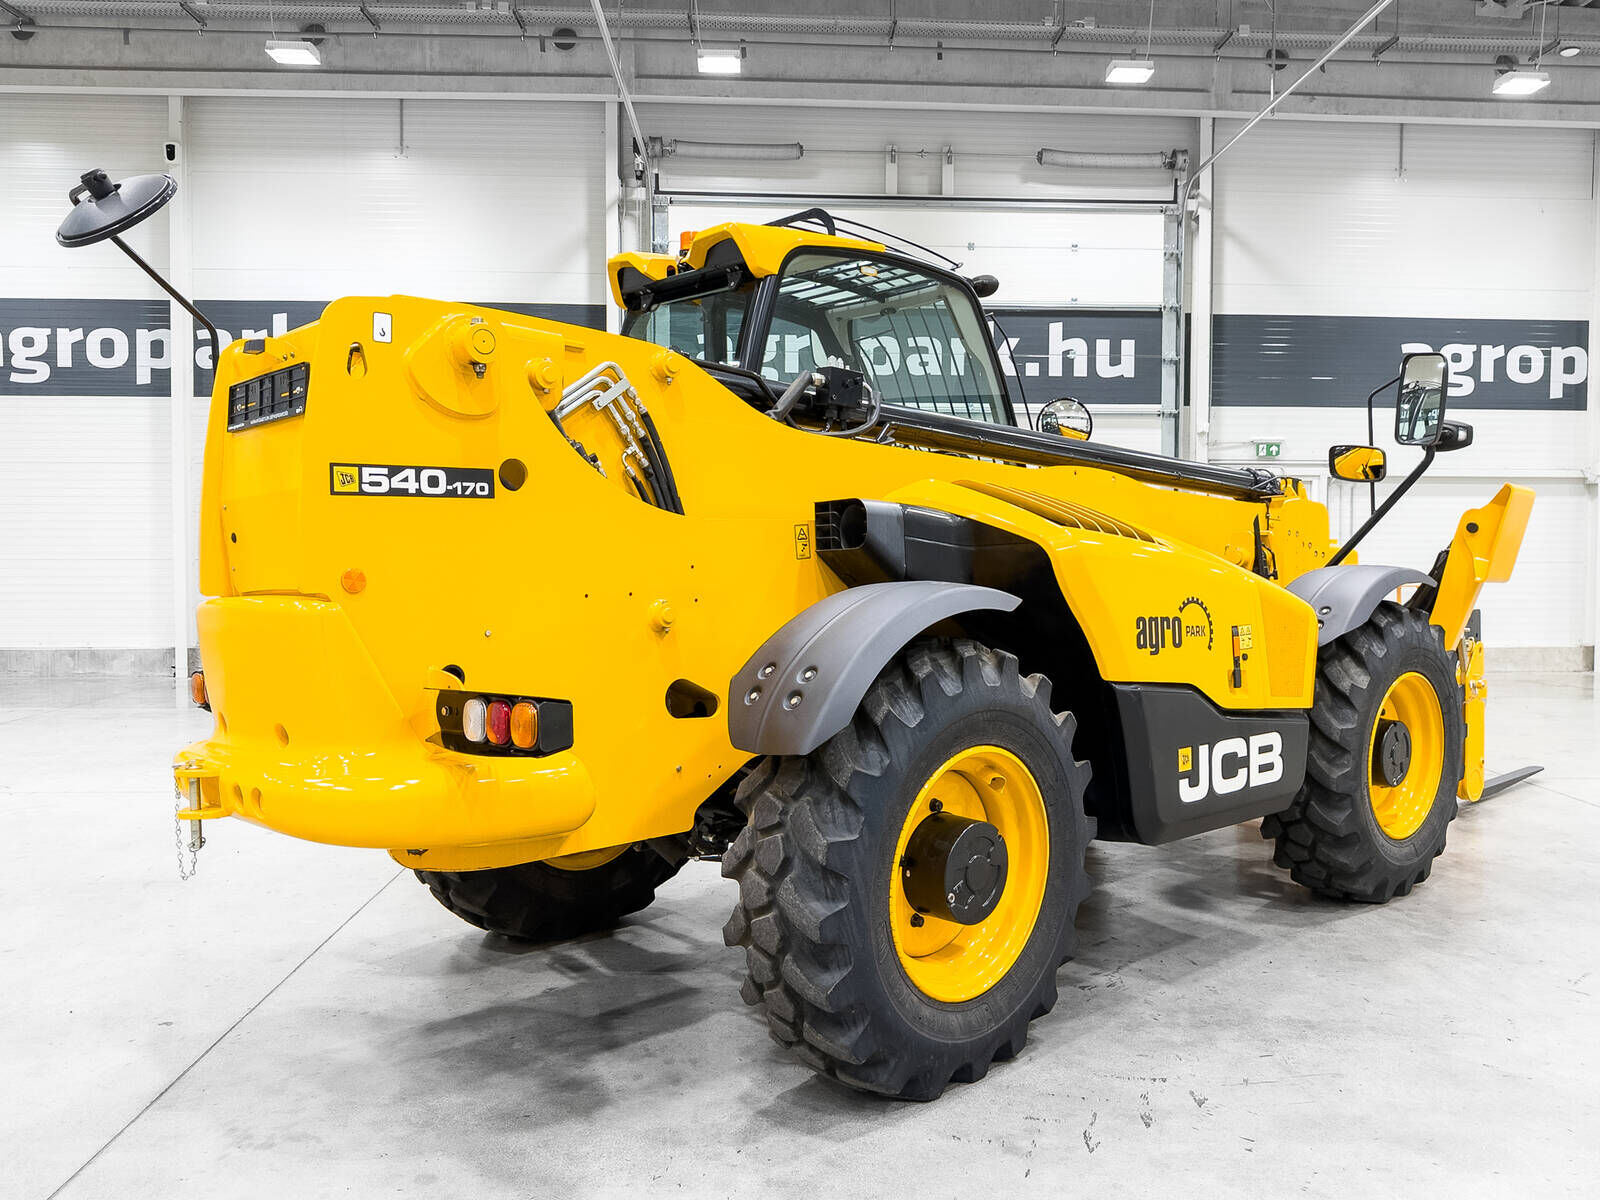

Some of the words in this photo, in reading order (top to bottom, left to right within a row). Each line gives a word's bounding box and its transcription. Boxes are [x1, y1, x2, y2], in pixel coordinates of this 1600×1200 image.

[1400, 343, 1588, 399] grop
[361, 467, 489, 495] 540-170
[1136, 616, 1182, 656] agro
[1185, 625, 1206, 637] PARK
[1179, 731, 1284, 803] JCB
